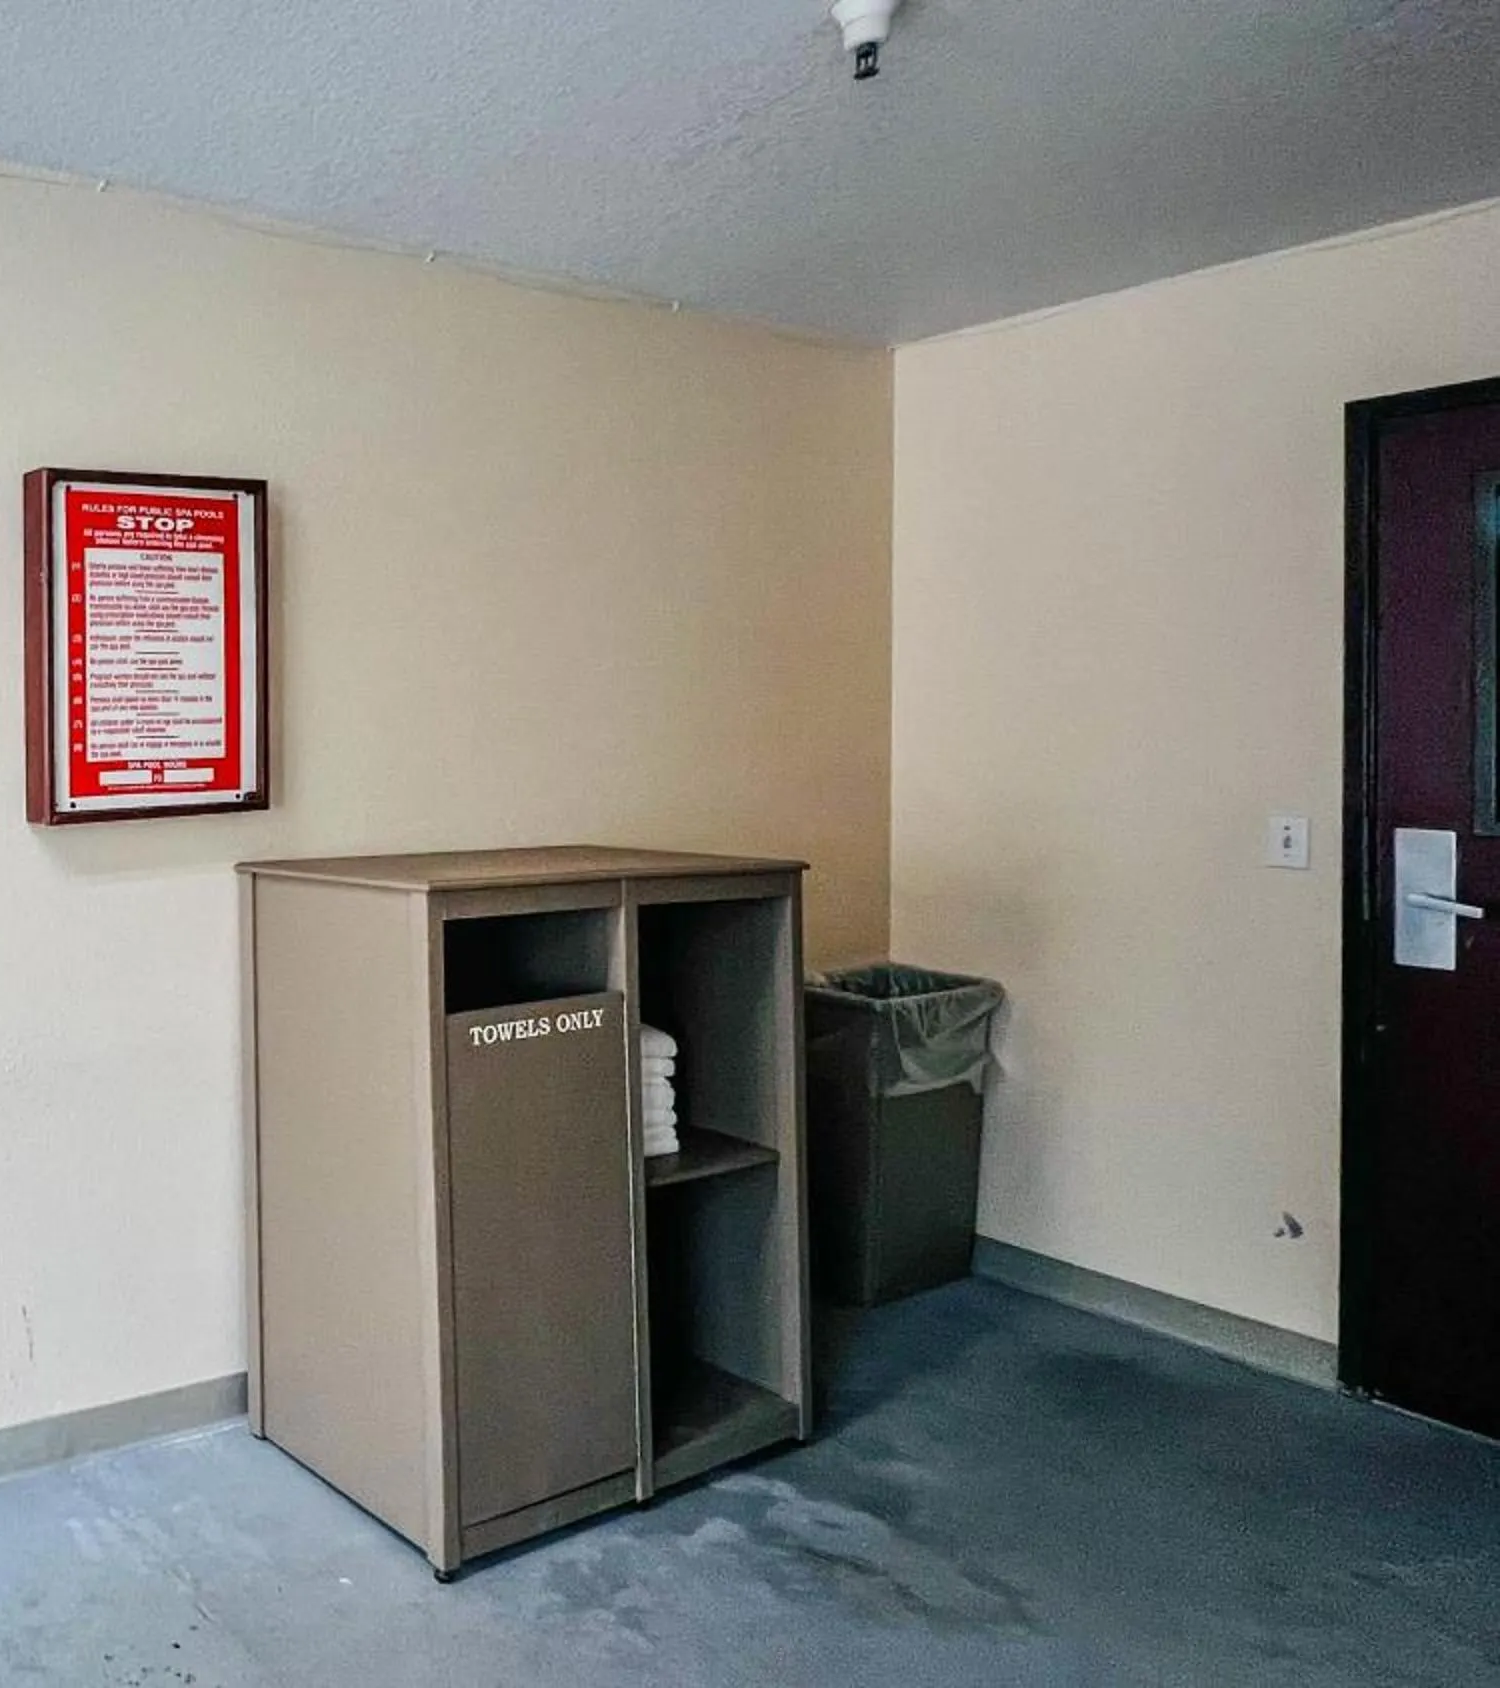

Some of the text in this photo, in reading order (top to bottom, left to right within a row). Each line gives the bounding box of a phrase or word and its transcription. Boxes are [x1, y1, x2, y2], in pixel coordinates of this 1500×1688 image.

[81, 503, 224, 519] RULES FOR PUBLIC SPA POOLS
[116, 515, 194, 532] STOP
[469, 1008, 604, 1046] TOWELS ONLY
